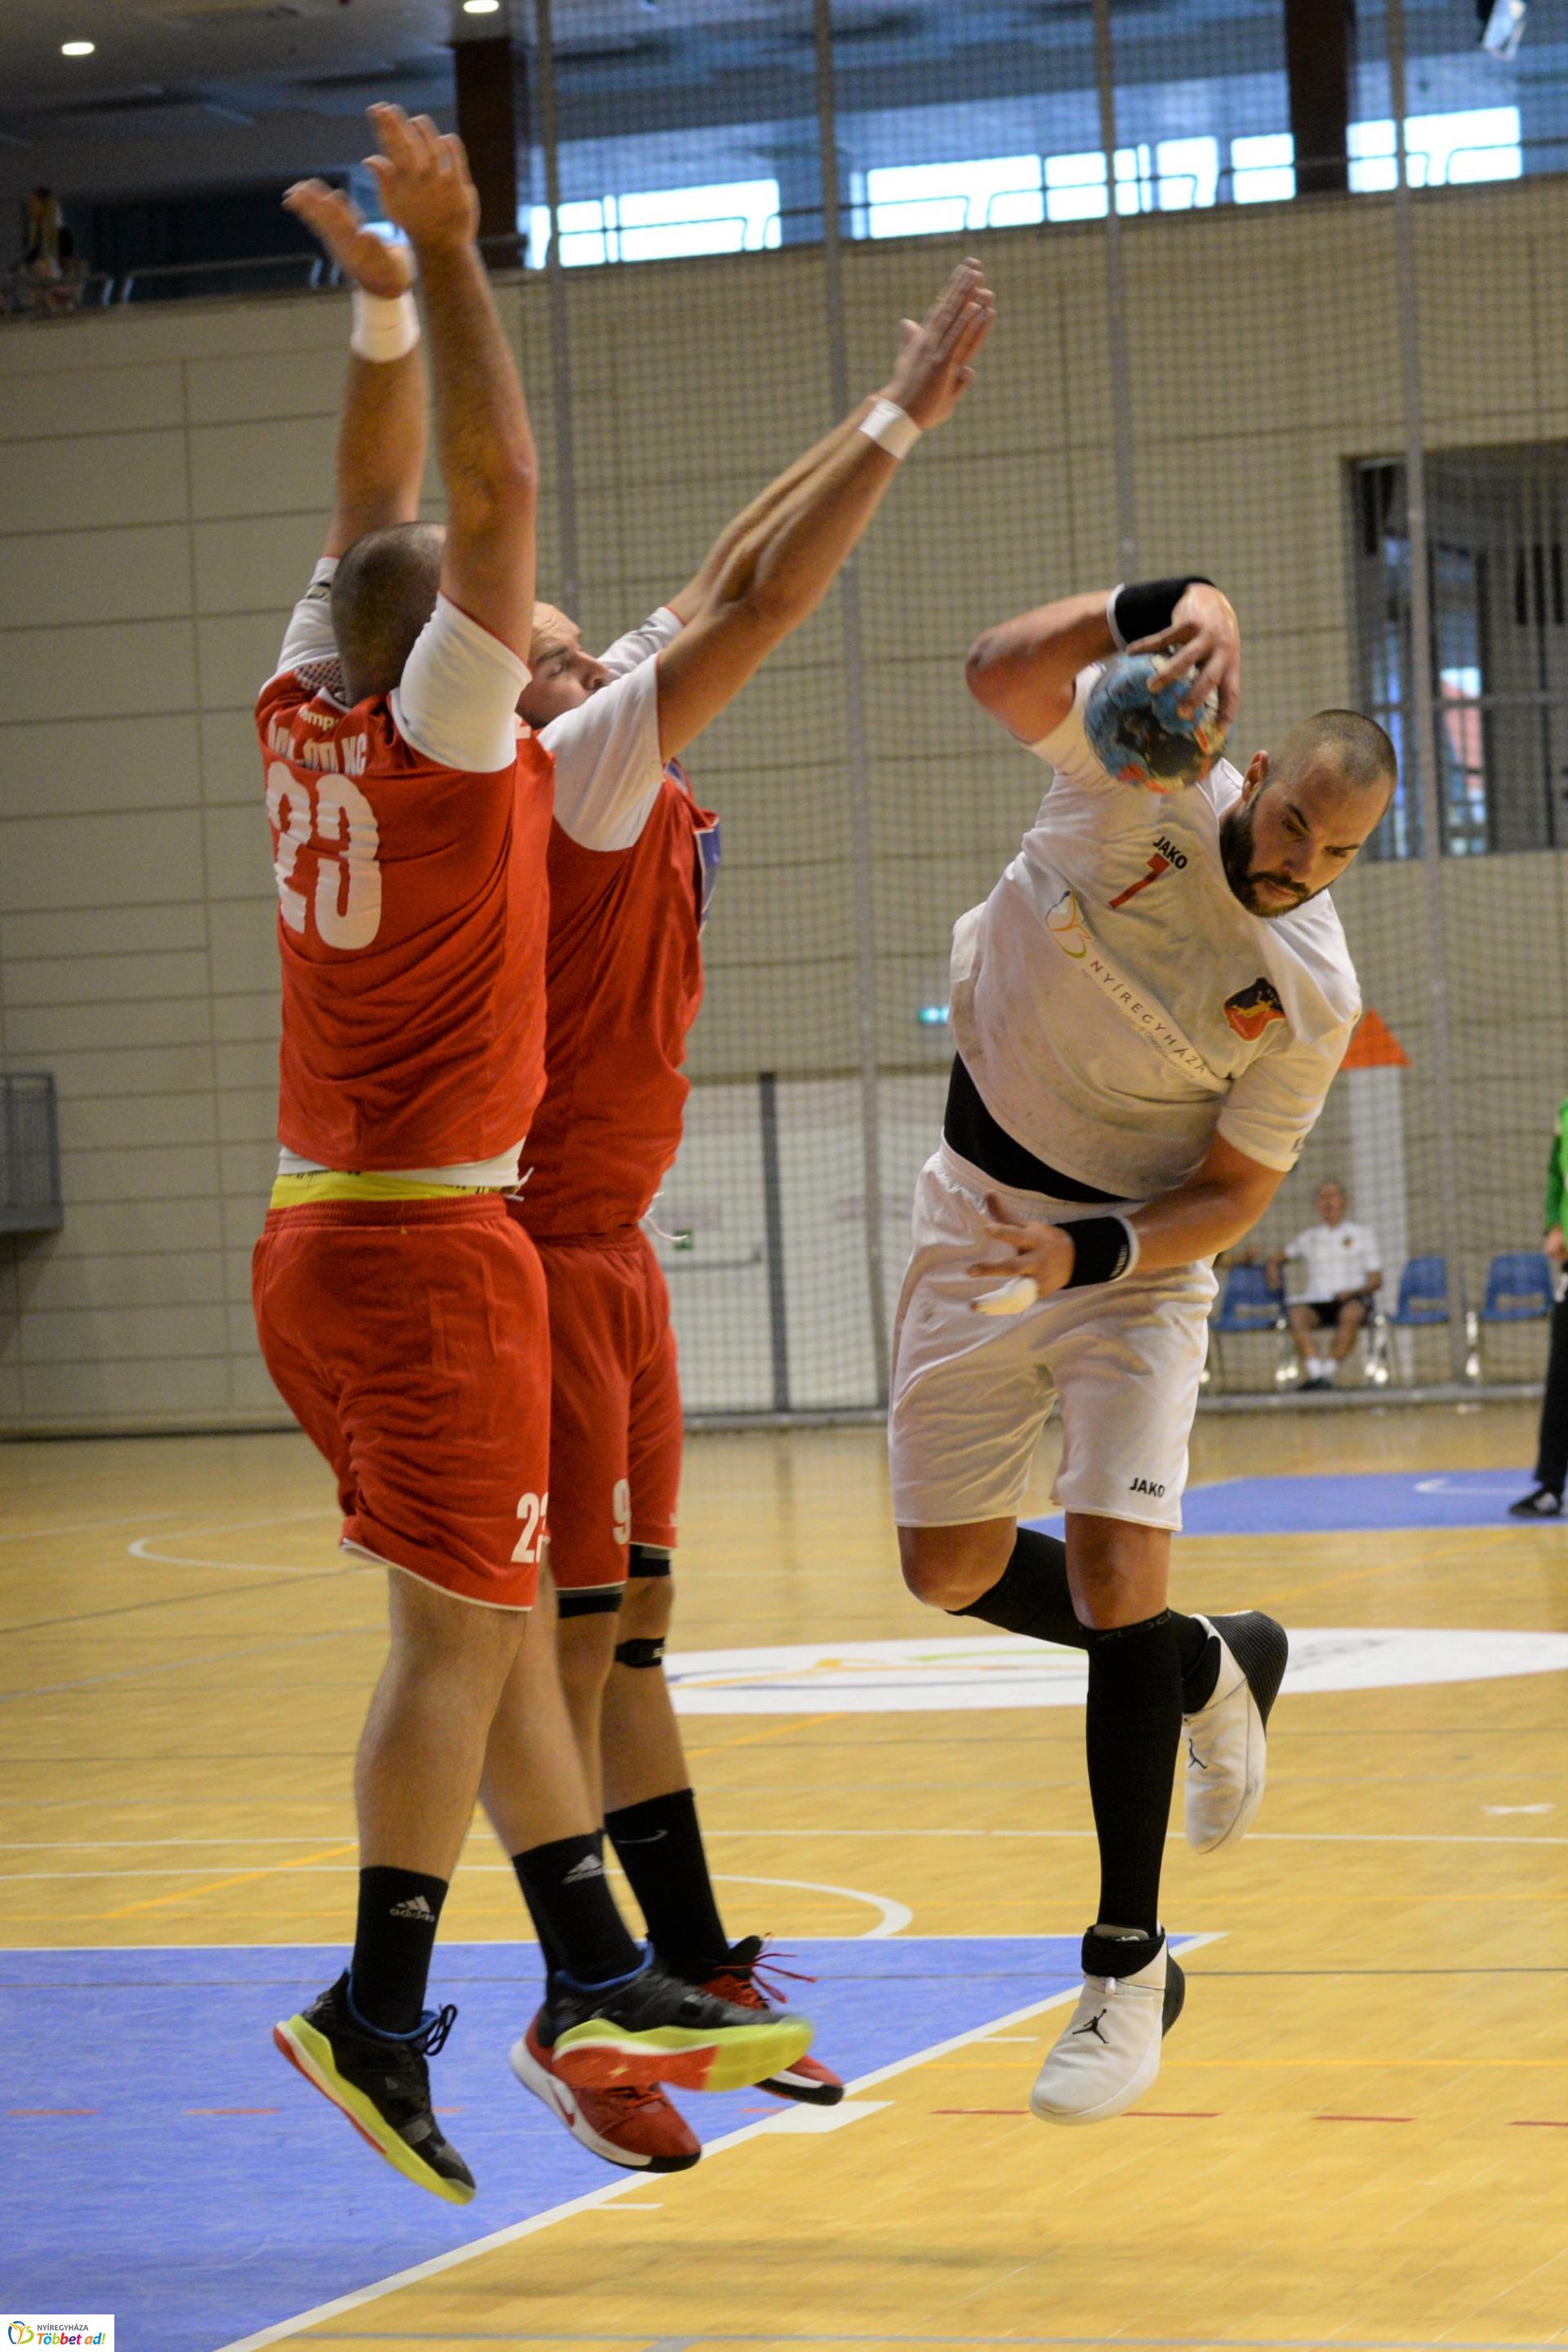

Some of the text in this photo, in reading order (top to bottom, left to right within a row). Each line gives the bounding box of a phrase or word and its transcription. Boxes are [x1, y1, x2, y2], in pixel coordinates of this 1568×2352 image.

[1152, 835, 1188, 870] JAKO
[1089, 960, 1208, 1074] NYÍREGYHÁZA
[1129, 1477, 1165, 1498] JAKO
[612, 1478, 632, 1545] 9
[390, 1908, 435, 1922] adidas
